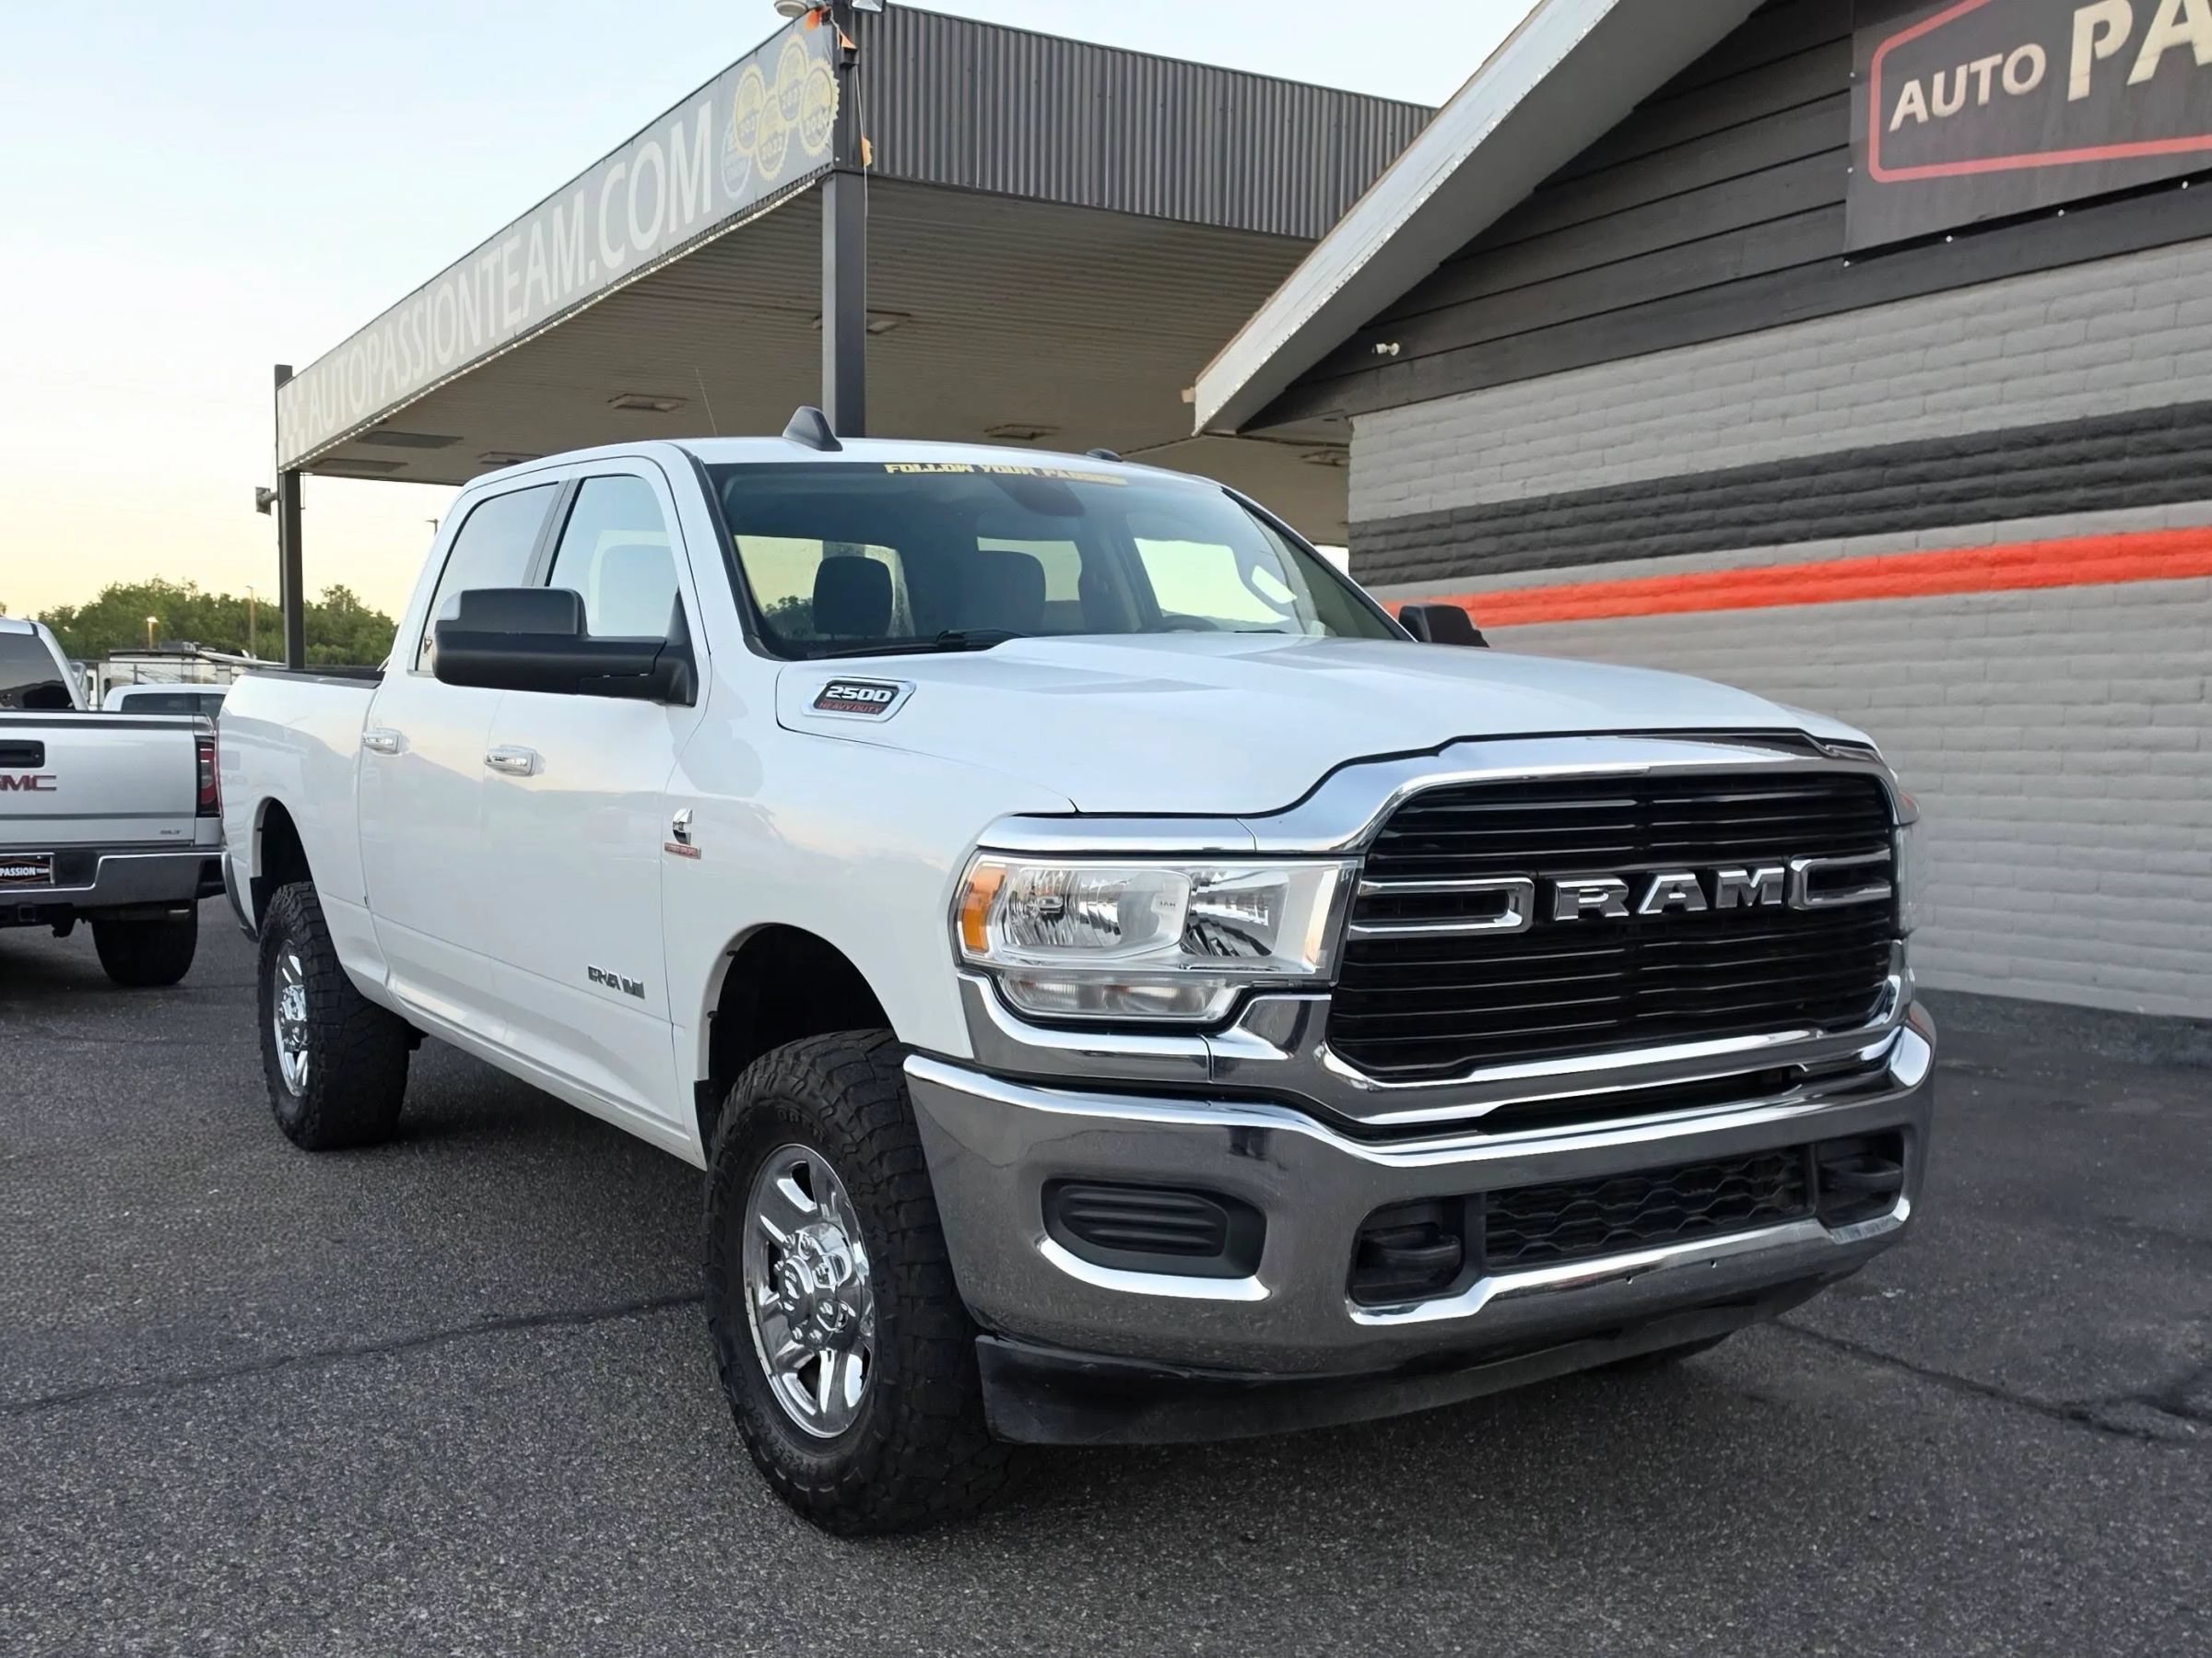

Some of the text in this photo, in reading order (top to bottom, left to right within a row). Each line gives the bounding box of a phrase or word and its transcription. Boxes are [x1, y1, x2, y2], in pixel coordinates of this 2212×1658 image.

[1888, 0, 2212, 132] AUTO PA
[308, 100, 713, 442] AUTOPASSIONTEAM.COM
[884, 464, 1037, 476] FOLLOW YOUR
[826, 686, 891, 702] 2500
[819, 702, 883, 713] HEAVY DUTY
[0, 774, 57, 791] MC
[1555, 867, 1785, 921] RAM
[587, 965, 646, 999] RAM
